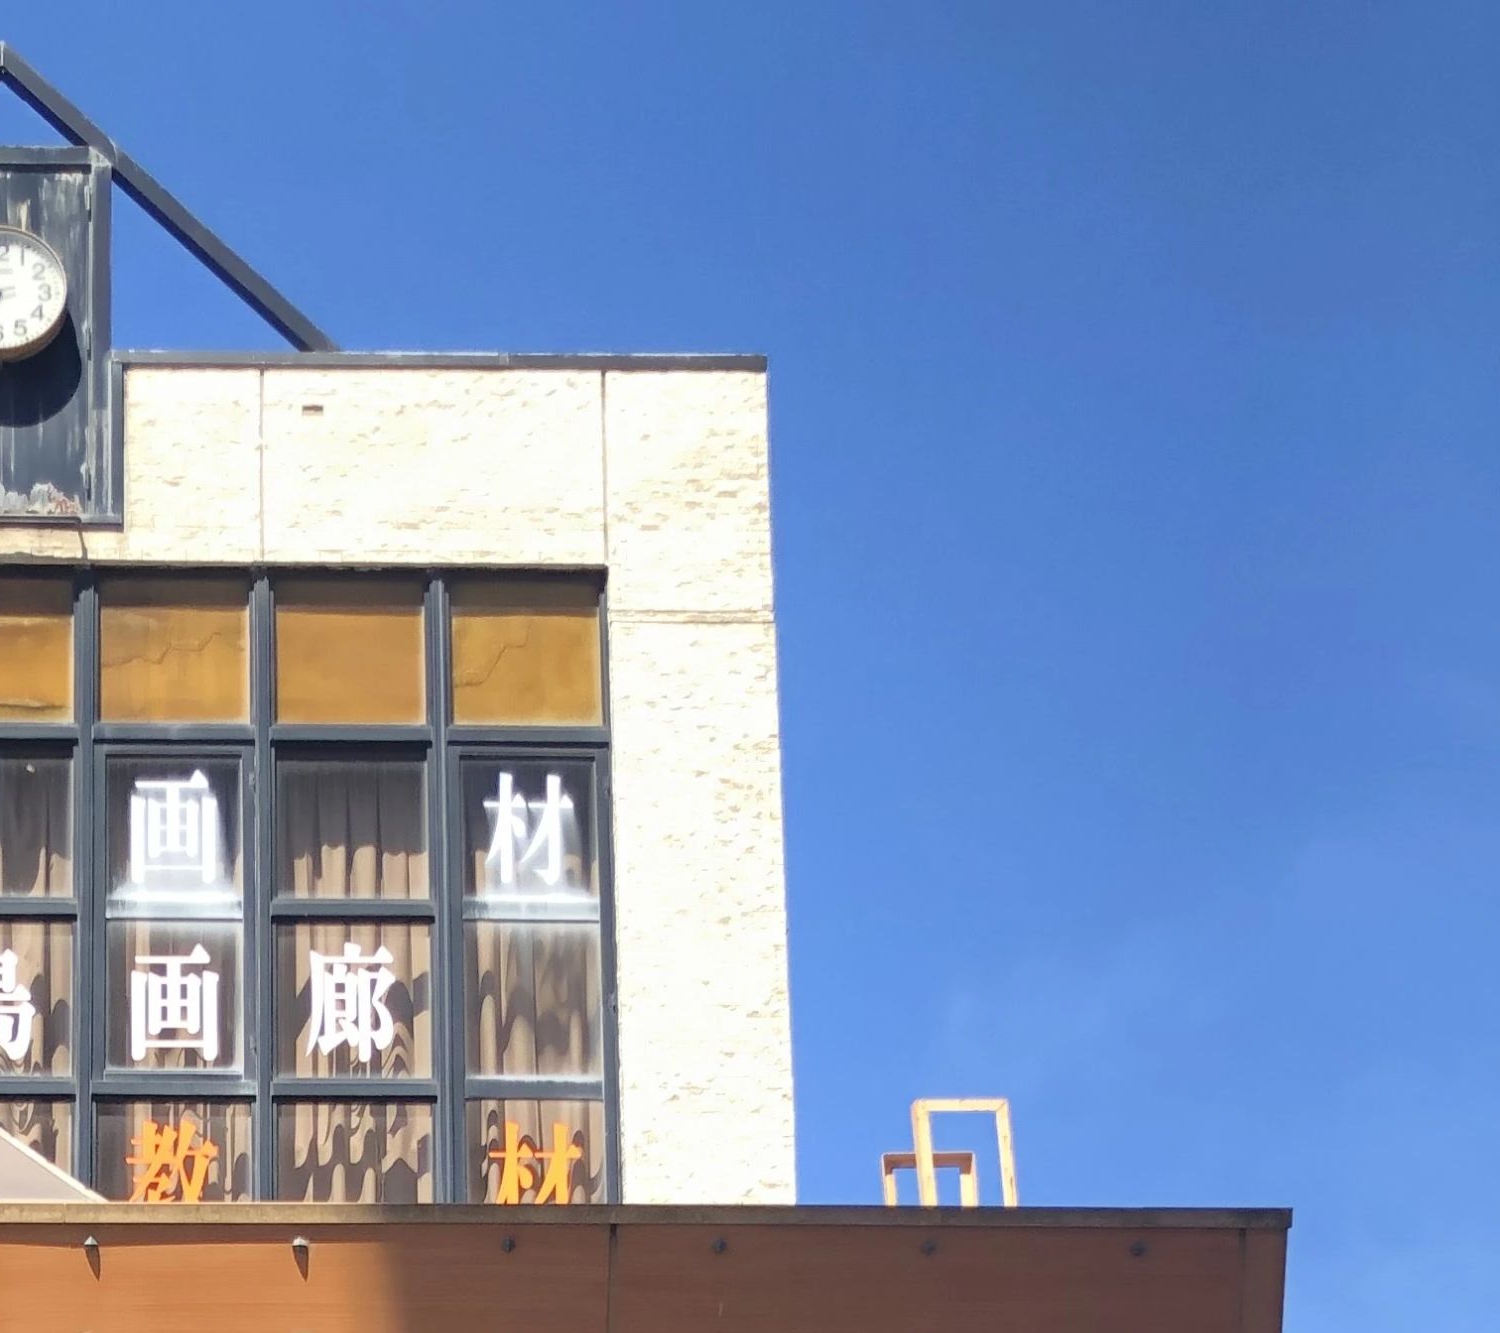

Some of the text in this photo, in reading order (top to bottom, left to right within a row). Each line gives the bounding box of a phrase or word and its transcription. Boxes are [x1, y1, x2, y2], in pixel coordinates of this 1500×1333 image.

[31, 262, 46, 281] 2
[37, 283, 52, 302] 3
[29, 303, 45, 321] 4
[12, 319, 28, 337] 5
